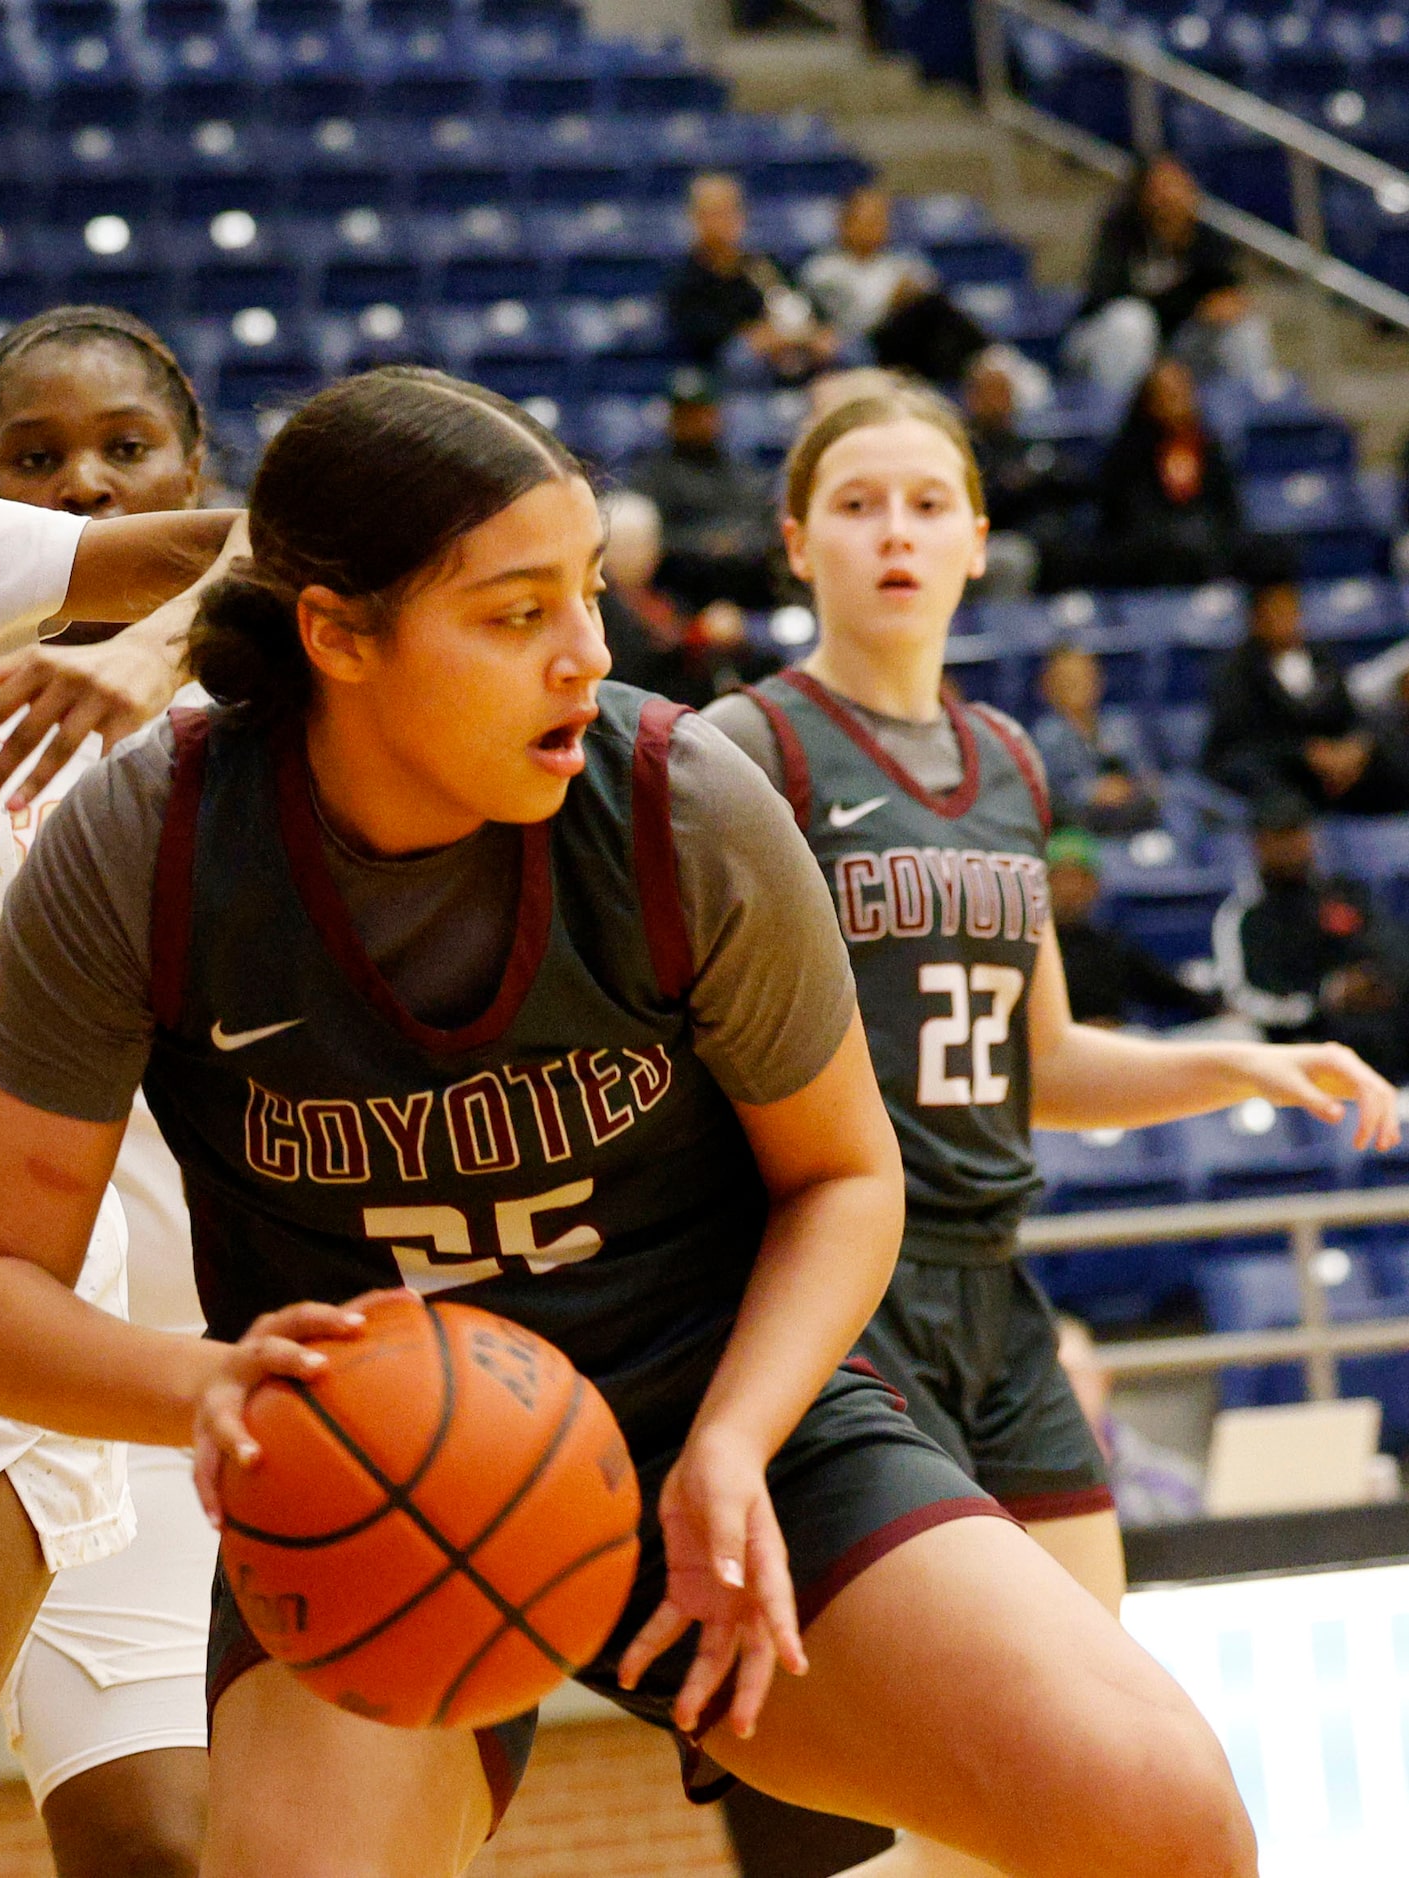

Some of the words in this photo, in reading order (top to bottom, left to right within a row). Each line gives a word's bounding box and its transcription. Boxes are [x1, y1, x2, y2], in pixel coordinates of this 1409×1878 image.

[917, 962, 1024, 1107] 22
[245, 1043, 672, 1184] COYOTES
[363, 1178, 603, 1296] 25
